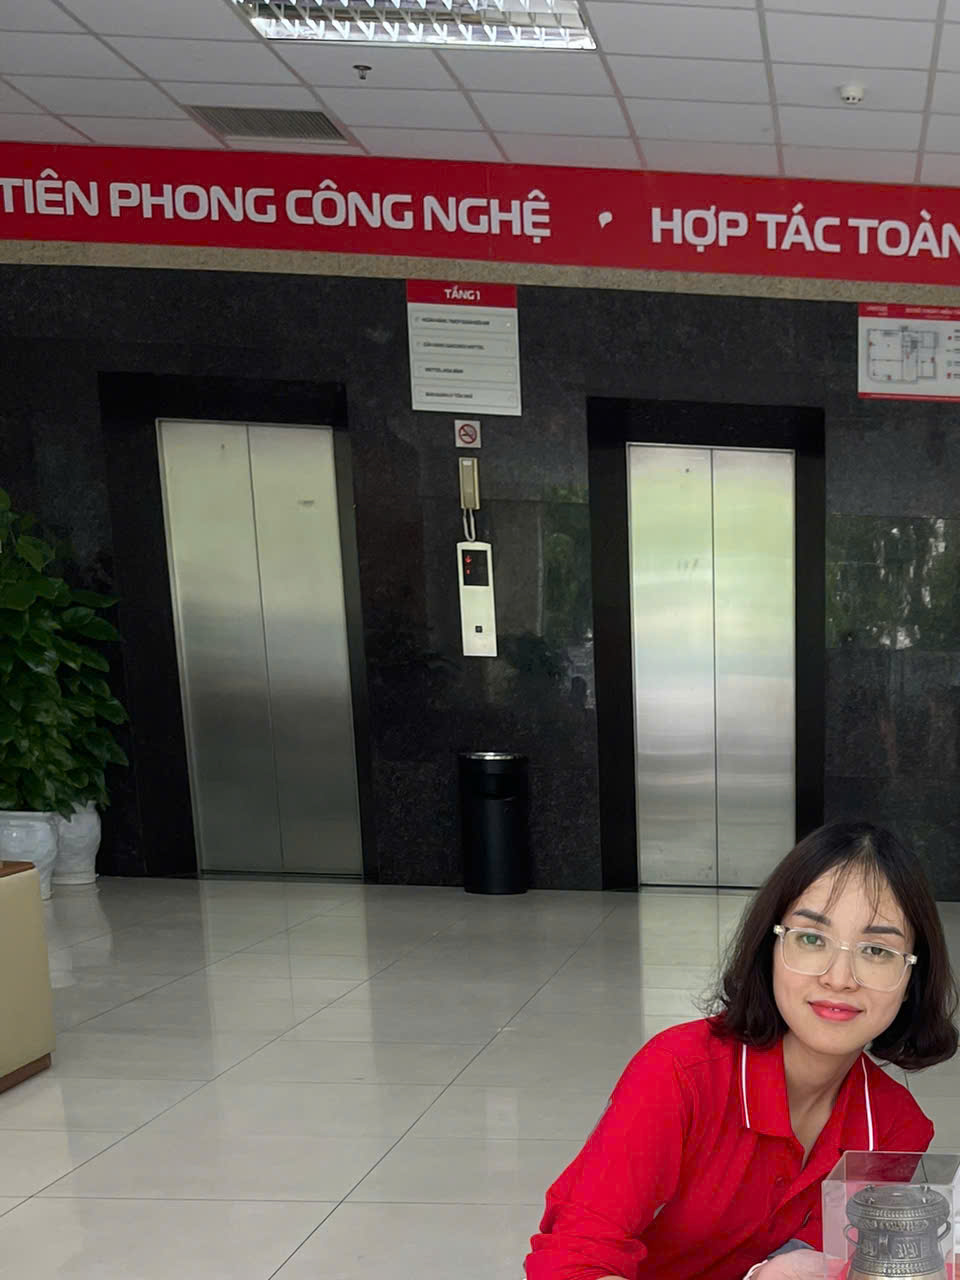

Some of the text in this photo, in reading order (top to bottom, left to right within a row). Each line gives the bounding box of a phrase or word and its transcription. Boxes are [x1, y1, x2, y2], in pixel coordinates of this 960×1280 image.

[0, 168, 550, 243] TIÊN PHONG CÔNG NGHỆ
[652, 205, 748, 252] HỢP
[756, 203, 840, 252] TÁC
